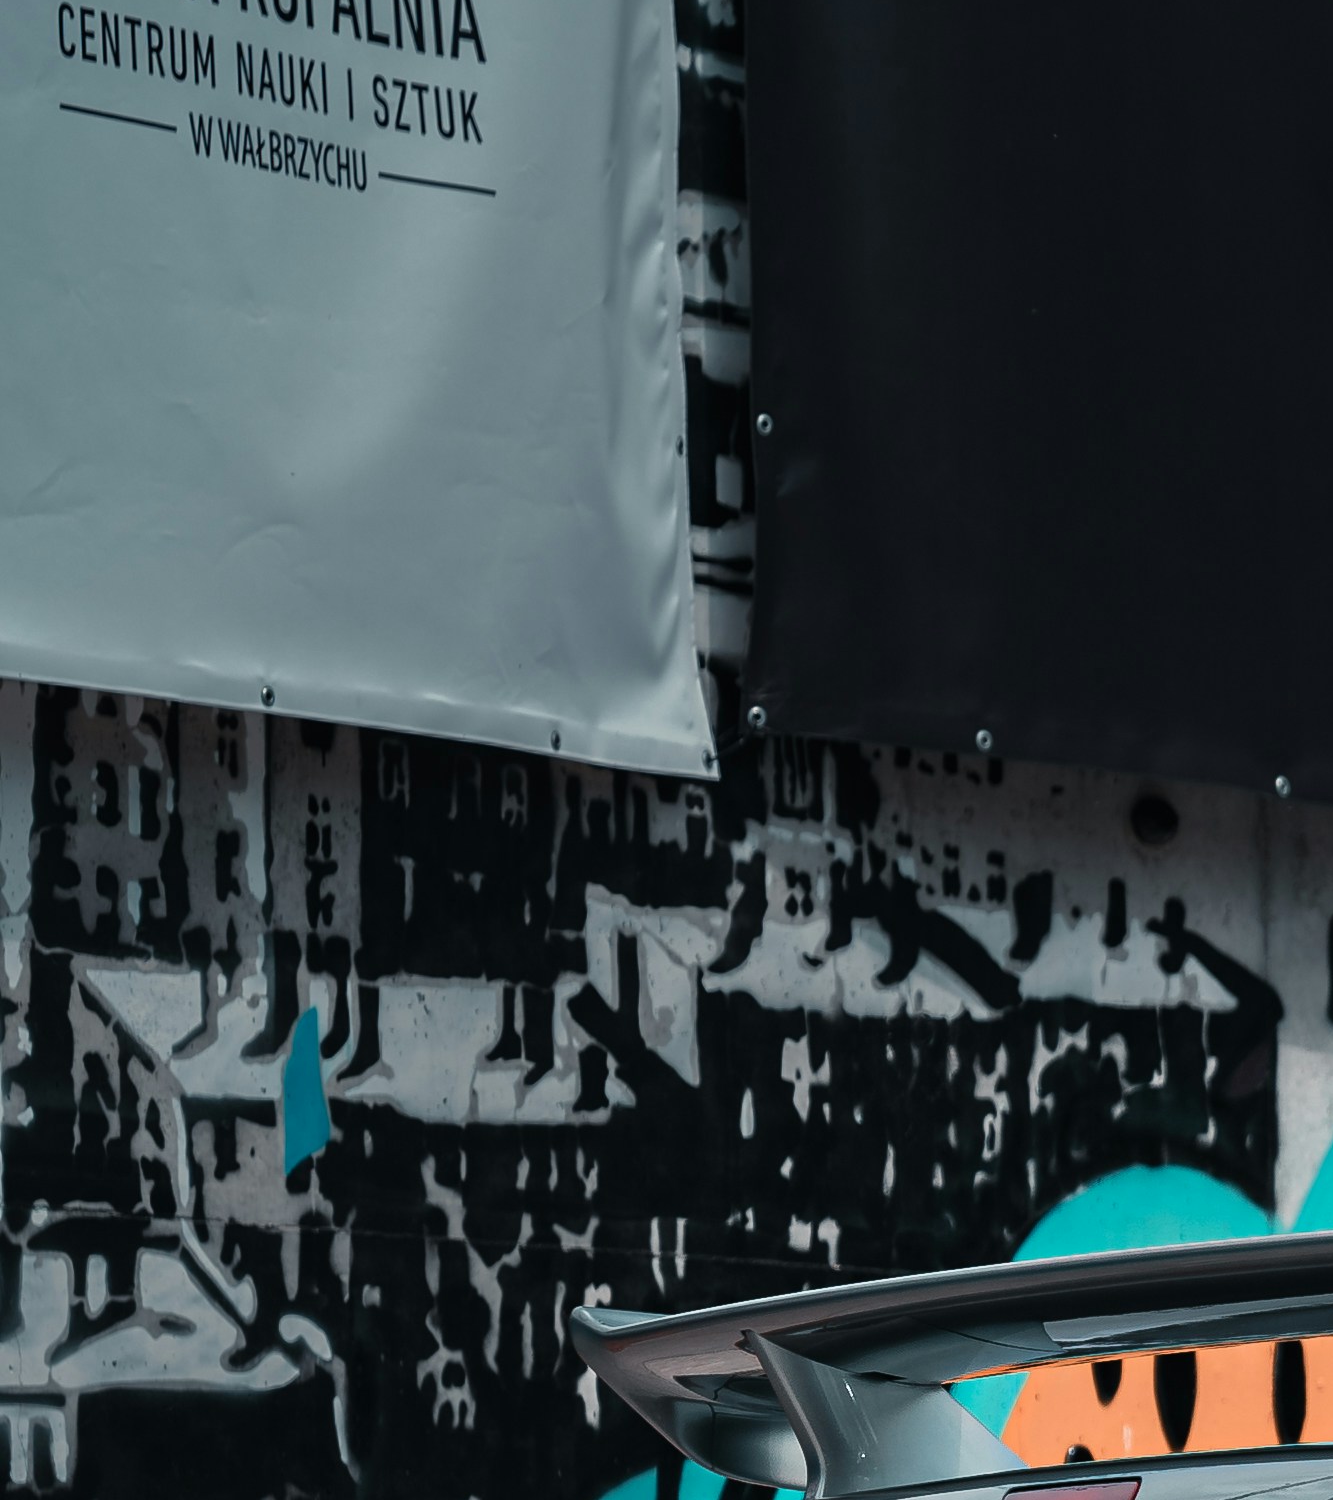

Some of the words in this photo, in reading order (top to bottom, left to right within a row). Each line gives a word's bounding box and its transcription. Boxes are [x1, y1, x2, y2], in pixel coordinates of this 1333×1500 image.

[58, 2, 217, 88] CENTRUM
[236, 41, 329, 115] NAUKI
[347, 67, 355, 120] I
[372, 75, 483, 144] SZTUK
[189, 111, 213, 158] W
[217, 117, 367, 192] WAŁBRZYCHU
